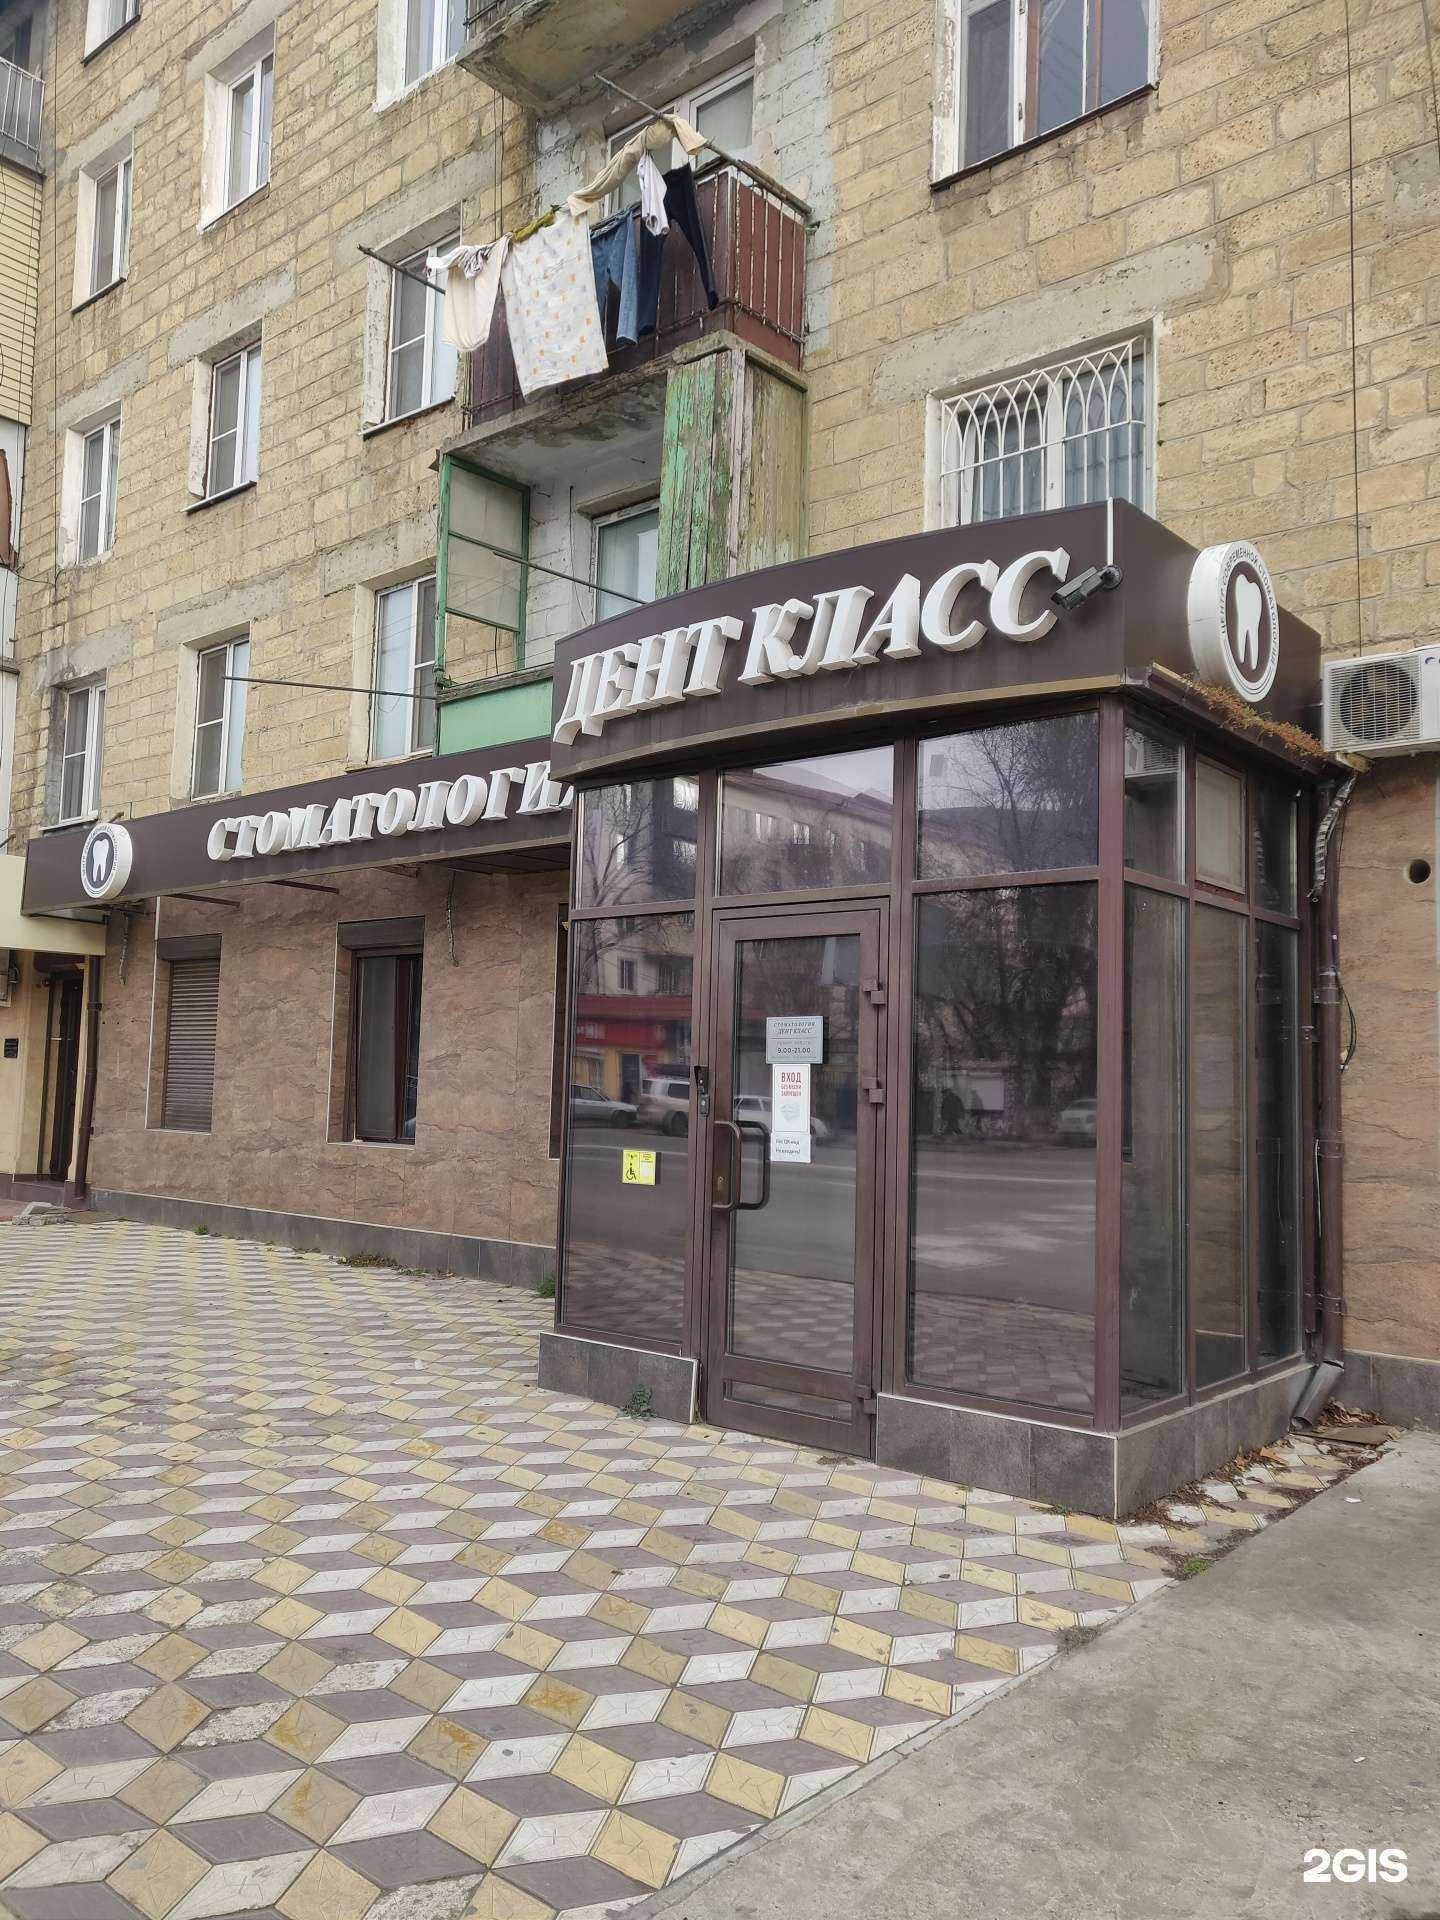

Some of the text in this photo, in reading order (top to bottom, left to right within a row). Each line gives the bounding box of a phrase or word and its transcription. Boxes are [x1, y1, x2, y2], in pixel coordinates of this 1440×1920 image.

[552, 546, 1071, 746] ДЕНТ КЛАСС
[206, 759, 574, 862] СТОМАТОЛОГИ
[781, 1071, 802, 1084] ВХОД
